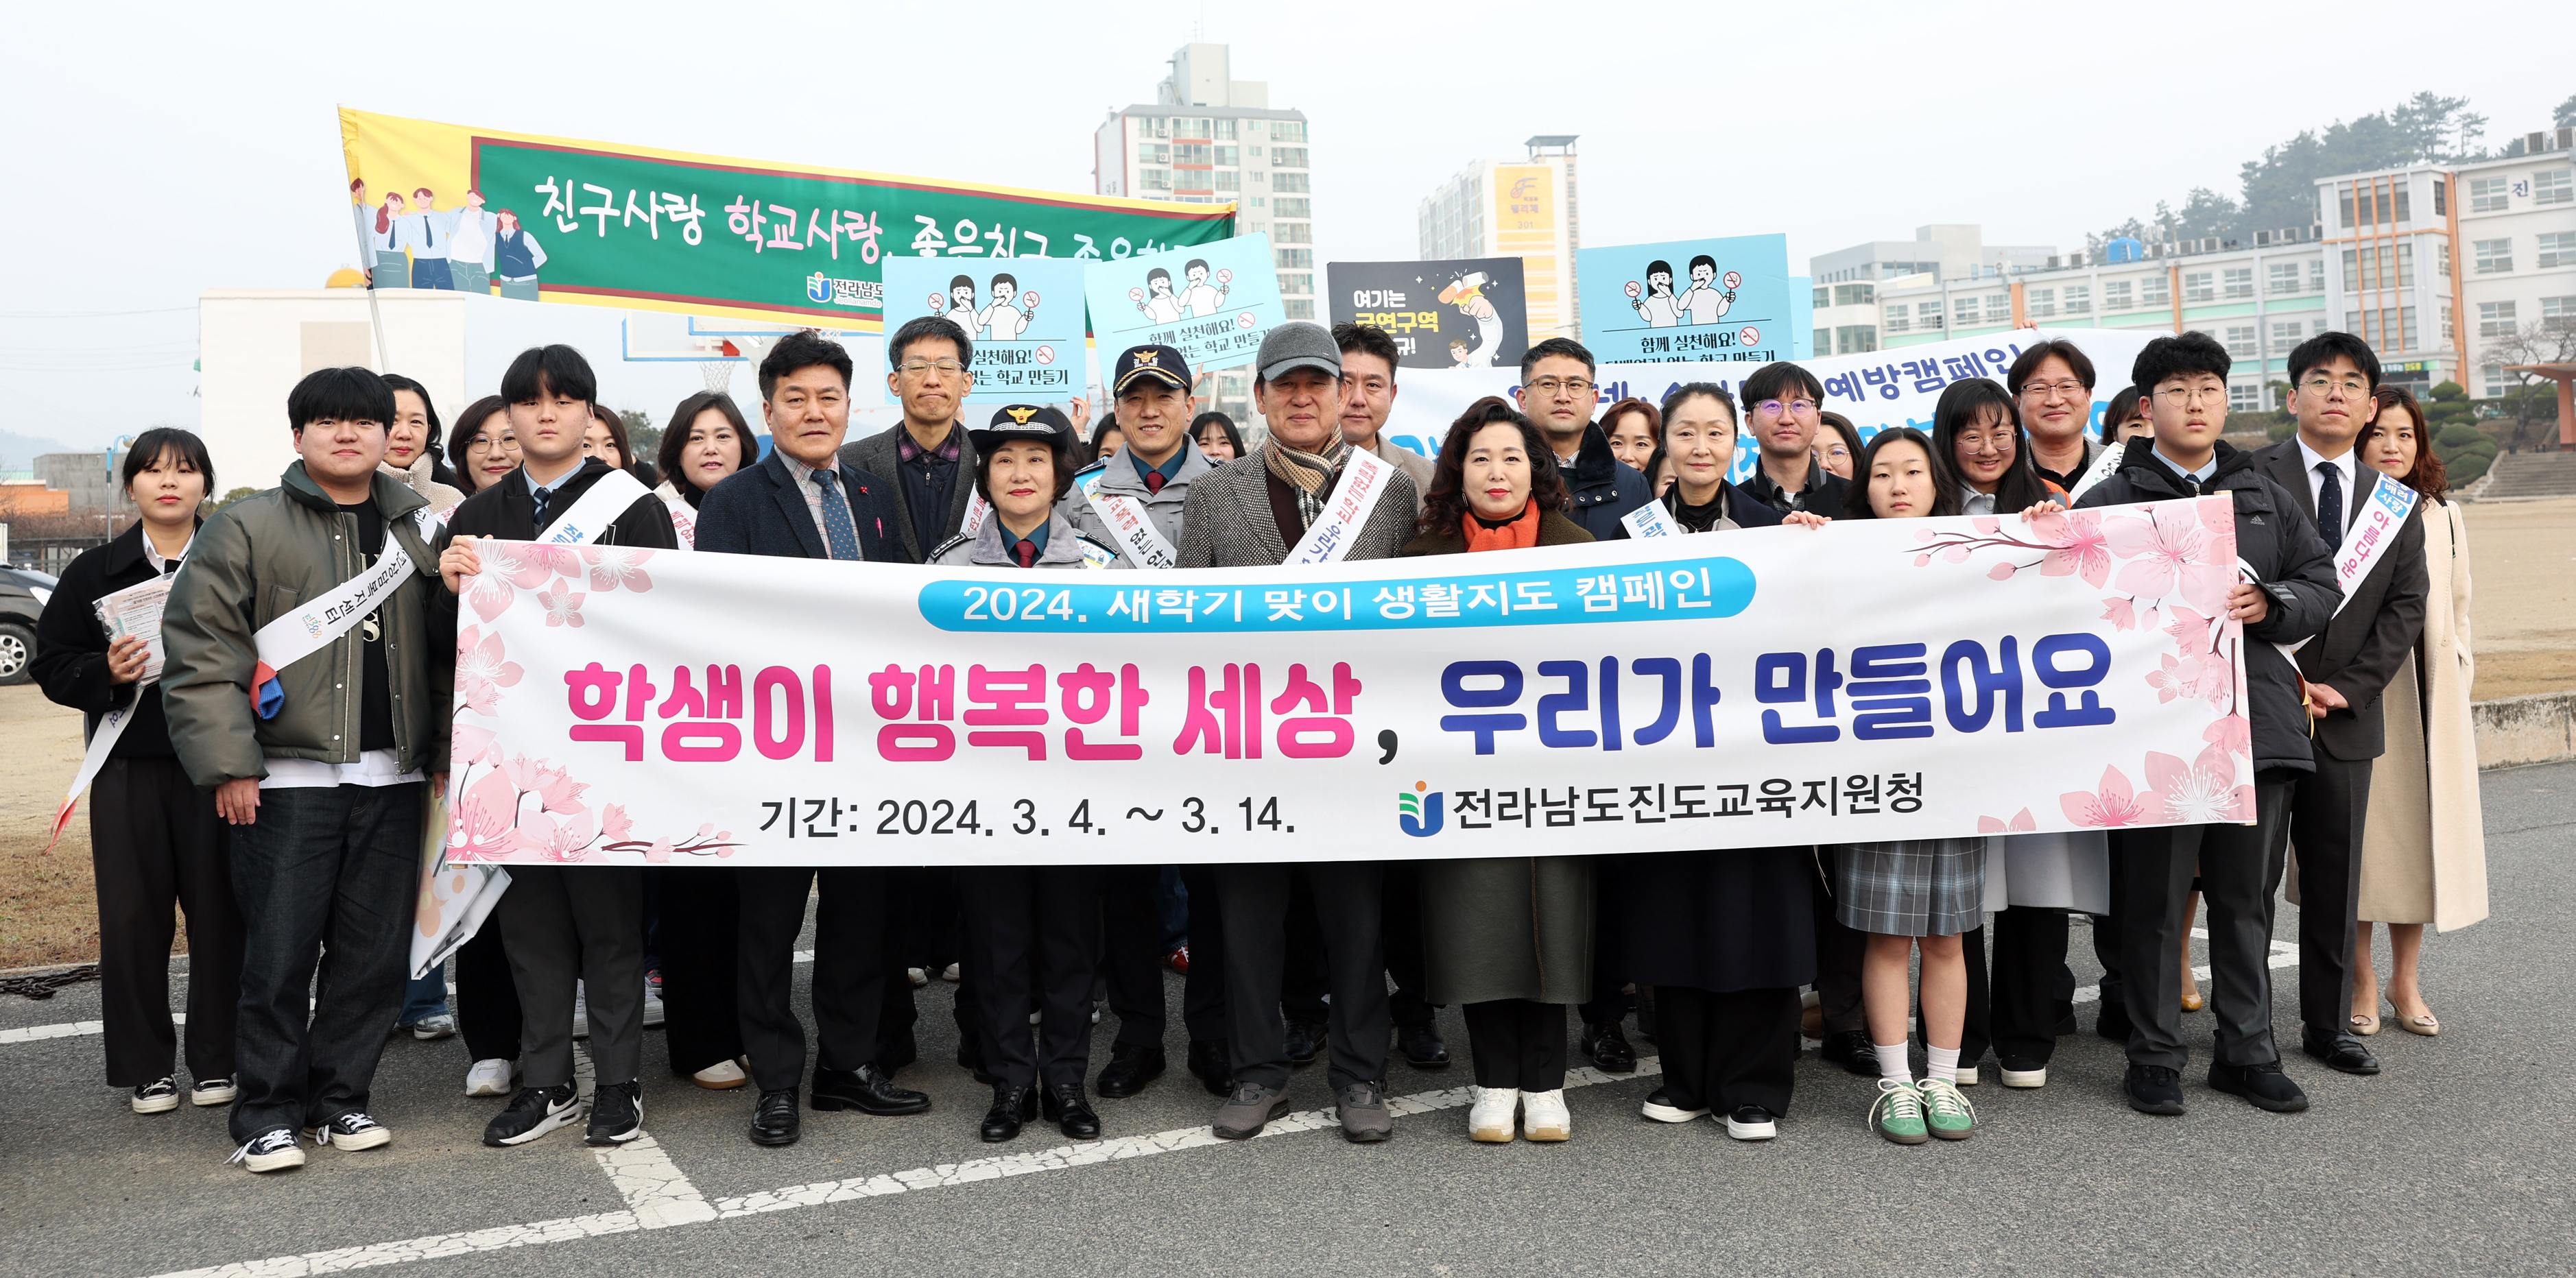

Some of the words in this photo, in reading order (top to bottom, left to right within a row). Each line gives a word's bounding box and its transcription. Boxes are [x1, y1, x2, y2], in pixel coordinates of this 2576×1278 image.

[2512, 180, 2529, 199] 진
[535, 176, 706, 245] 친구사랑
[724, 195, 892, 265] 학교사랑,
[1518, 221, 1534, 229] 301
[835, 297, 882, 307] Jeollanamdo
[1353, 289, 1406, 309] 여기는
[1149, 330, 1176, 345] 함께
[1180, 319, 1235, 341] 실천해요!
[1641, 336, 1671, 354] 함께
[1673, 331, 1737, 352] 실천해요!
[973, 349, 1031, 365] 실천해요!
[1204, 338, 1232, 354] 학교
[997, 370, 1024, 385] 학교
[1028, 369, 1068, 385] 만들기
[1824, 343, 2021, 402] 예방캠페인
[2379, 492, 2405, 514] 사랑
[2385, 482, 2409, 501] 배려
[1130, 527, 1154, 555] 없는
[1309, 525, 1341, 563] 우리가
[2341, 511, 2391, 578] 아름다운
[962, 586, 1088, 623] 2024.
[1106, 589, 1242, 623] 새학기
[1264, 587, 1351, 623] 맞이
[1372, 581, 1559, 620] 생활지도
[1576, 566, 1713, 614] 캠페인
[564, 661, 835, 762] 학생이
[868, 662, 1149, 762] 행복한
[1173, 662, 1398, 765] 세상,
[1440, 652, 1721, 756] 우리가
[1754, 632, 2116, 745] 만들어요
[1453, 773, 1923, 829] 전라남도진도교육지원청
[759, 796, 859, 839] 기간:
[876, 799, 993, 837] 2024.
[1012, 798, 1049, 837] 3.
[1068, 798, 1106, 836] 4.
[1182, 796, 1219, 834] 3.
[1238, 795, 1295, 833] 14.
